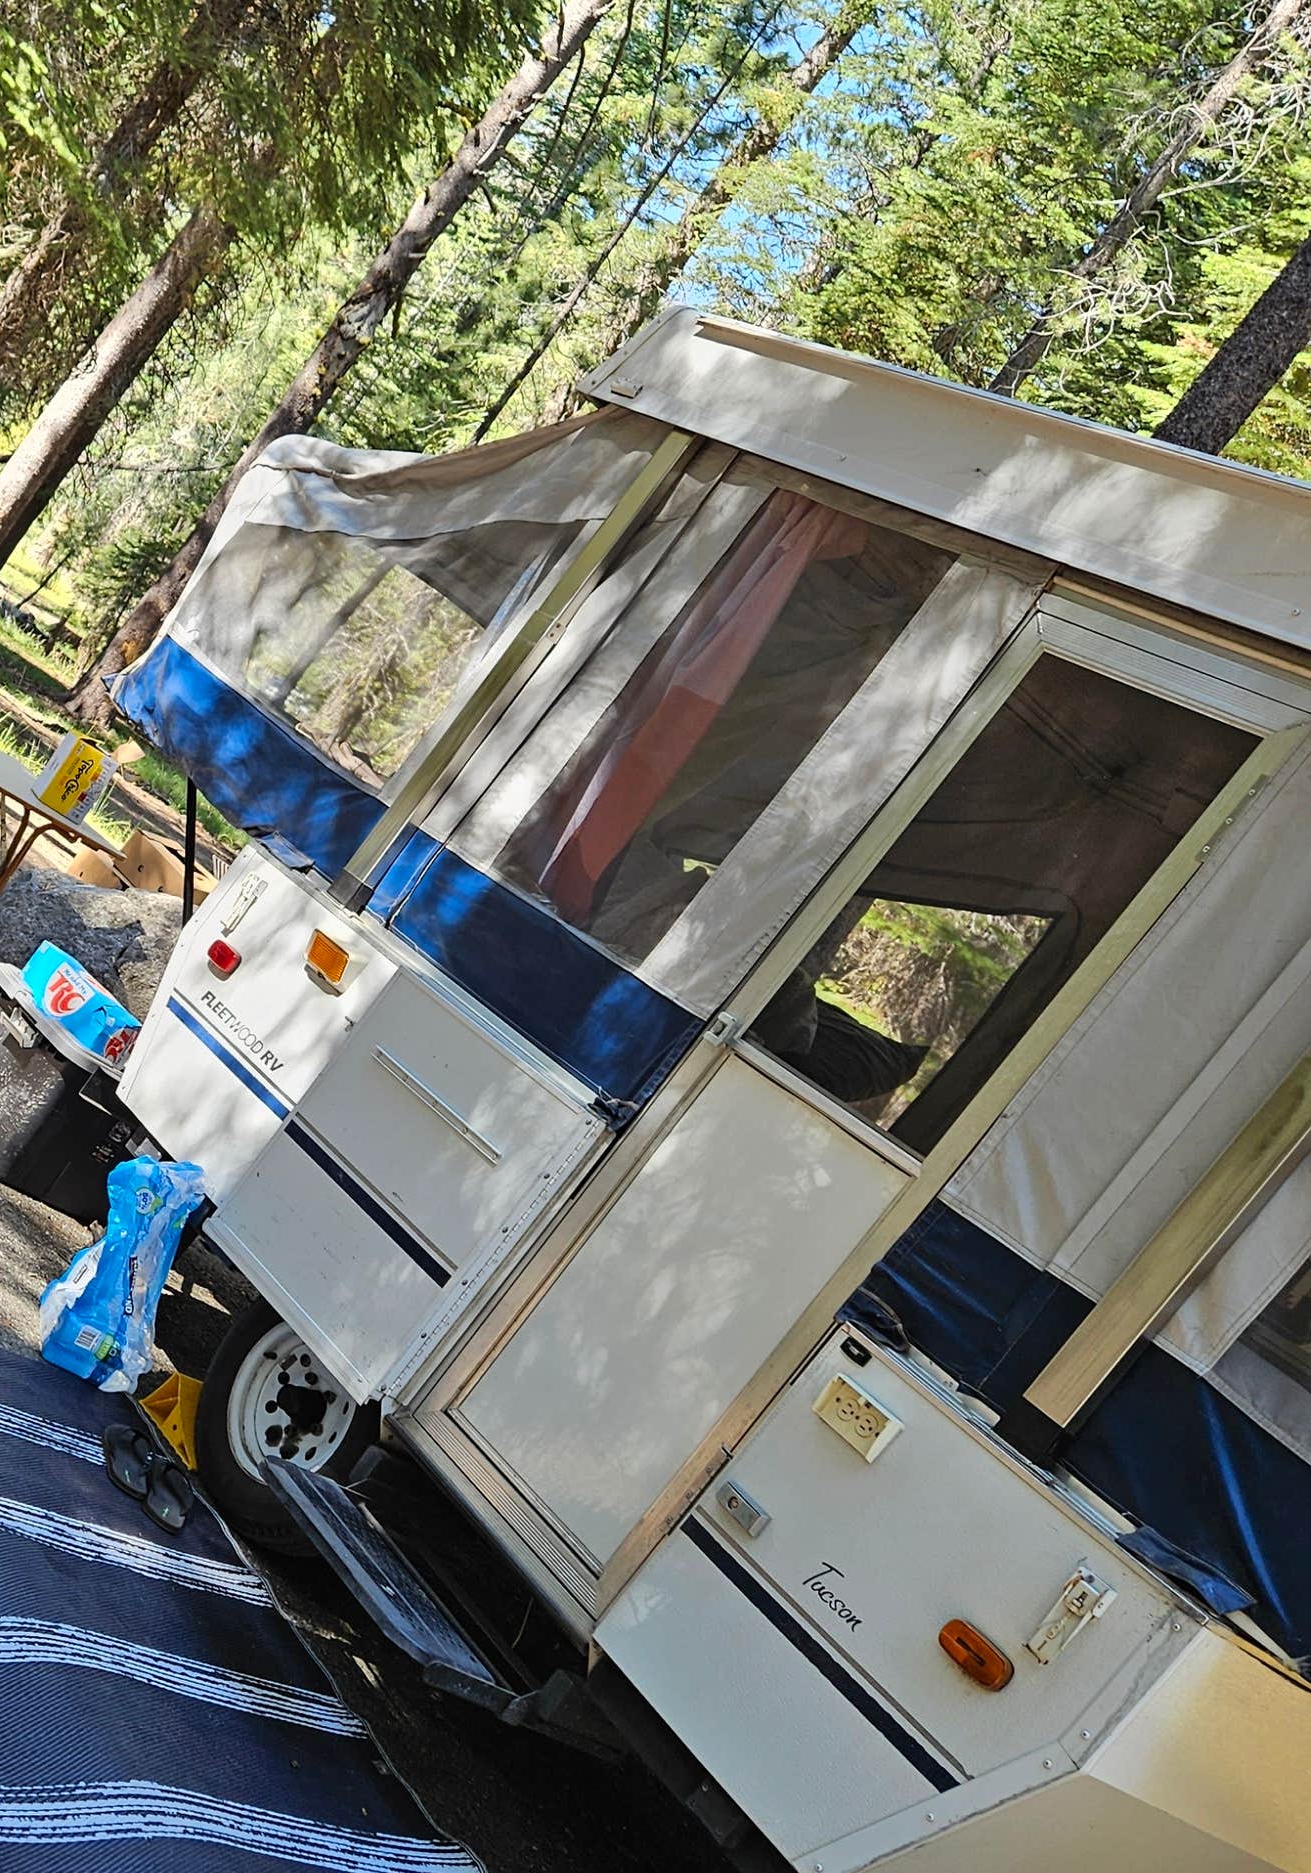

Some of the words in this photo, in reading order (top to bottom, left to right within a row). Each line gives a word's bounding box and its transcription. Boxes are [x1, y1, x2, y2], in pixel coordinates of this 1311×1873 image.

[76, 760, 94, 780] Topo
[61, 779, 79, 801] Chico
[49, 977, 85, 1013] RC
[201, 991, 264, 1054] FLEETWOOD
[260, 1050, 284, 1071] RV
[802, 1562, 862, 1632] Tucson
